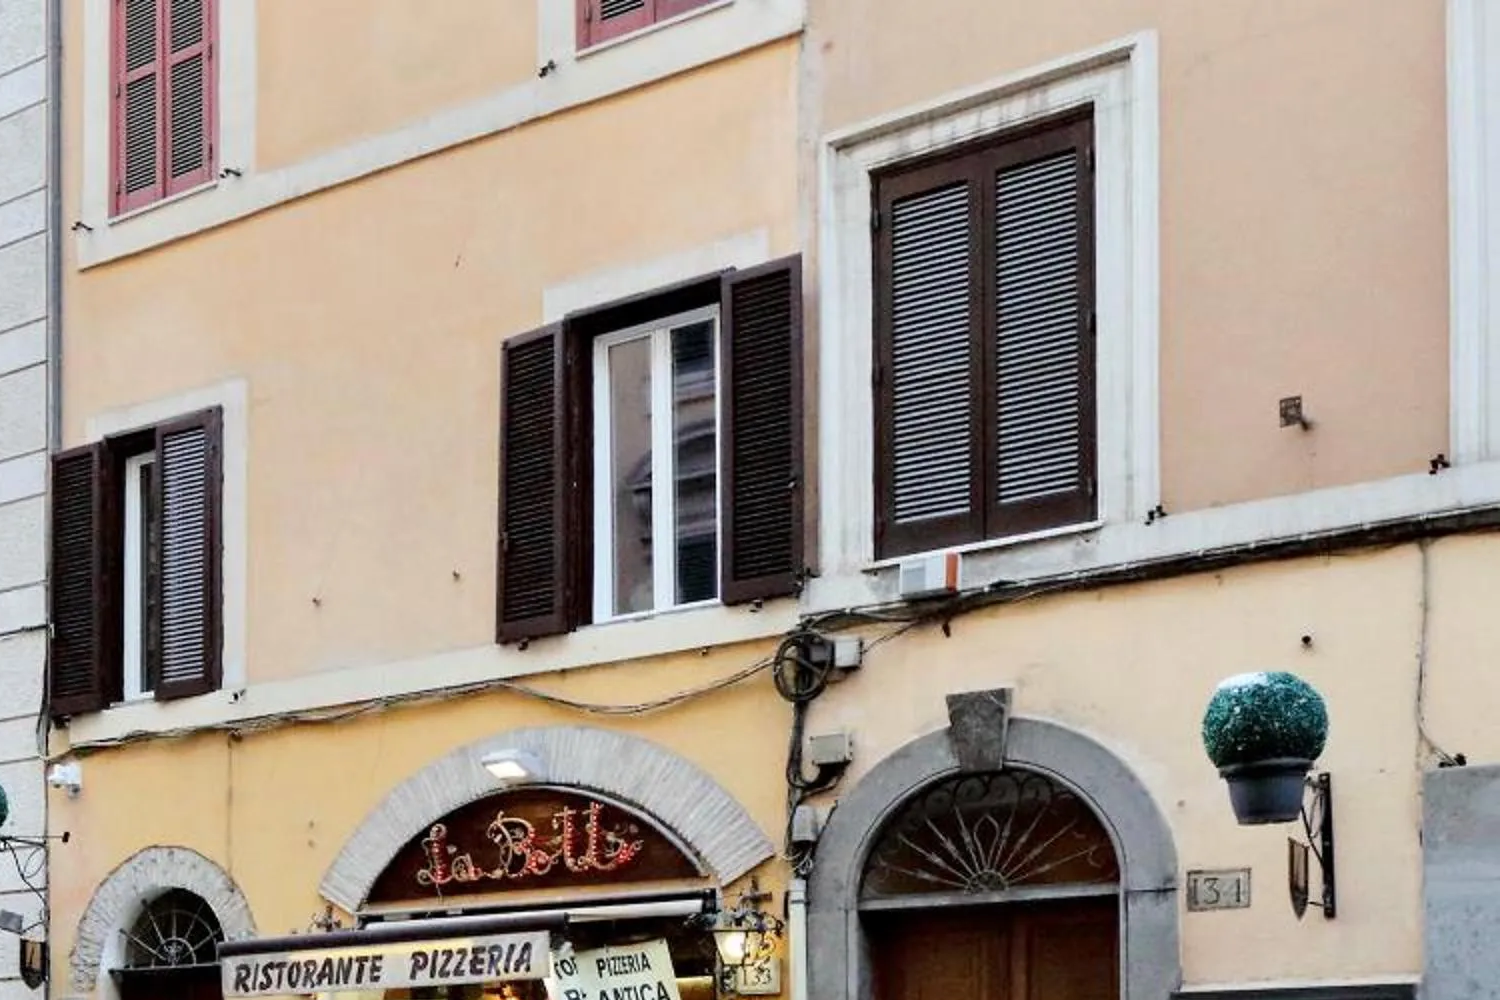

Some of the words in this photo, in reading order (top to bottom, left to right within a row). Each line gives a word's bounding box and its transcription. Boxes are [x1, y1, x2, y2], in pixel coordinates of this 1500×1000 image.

[233, 954, 384, 993] RISTORANTE
[409, 941, 533, 980] PIZZERIA
[596, 951, 652, 979] PIZZERIA
